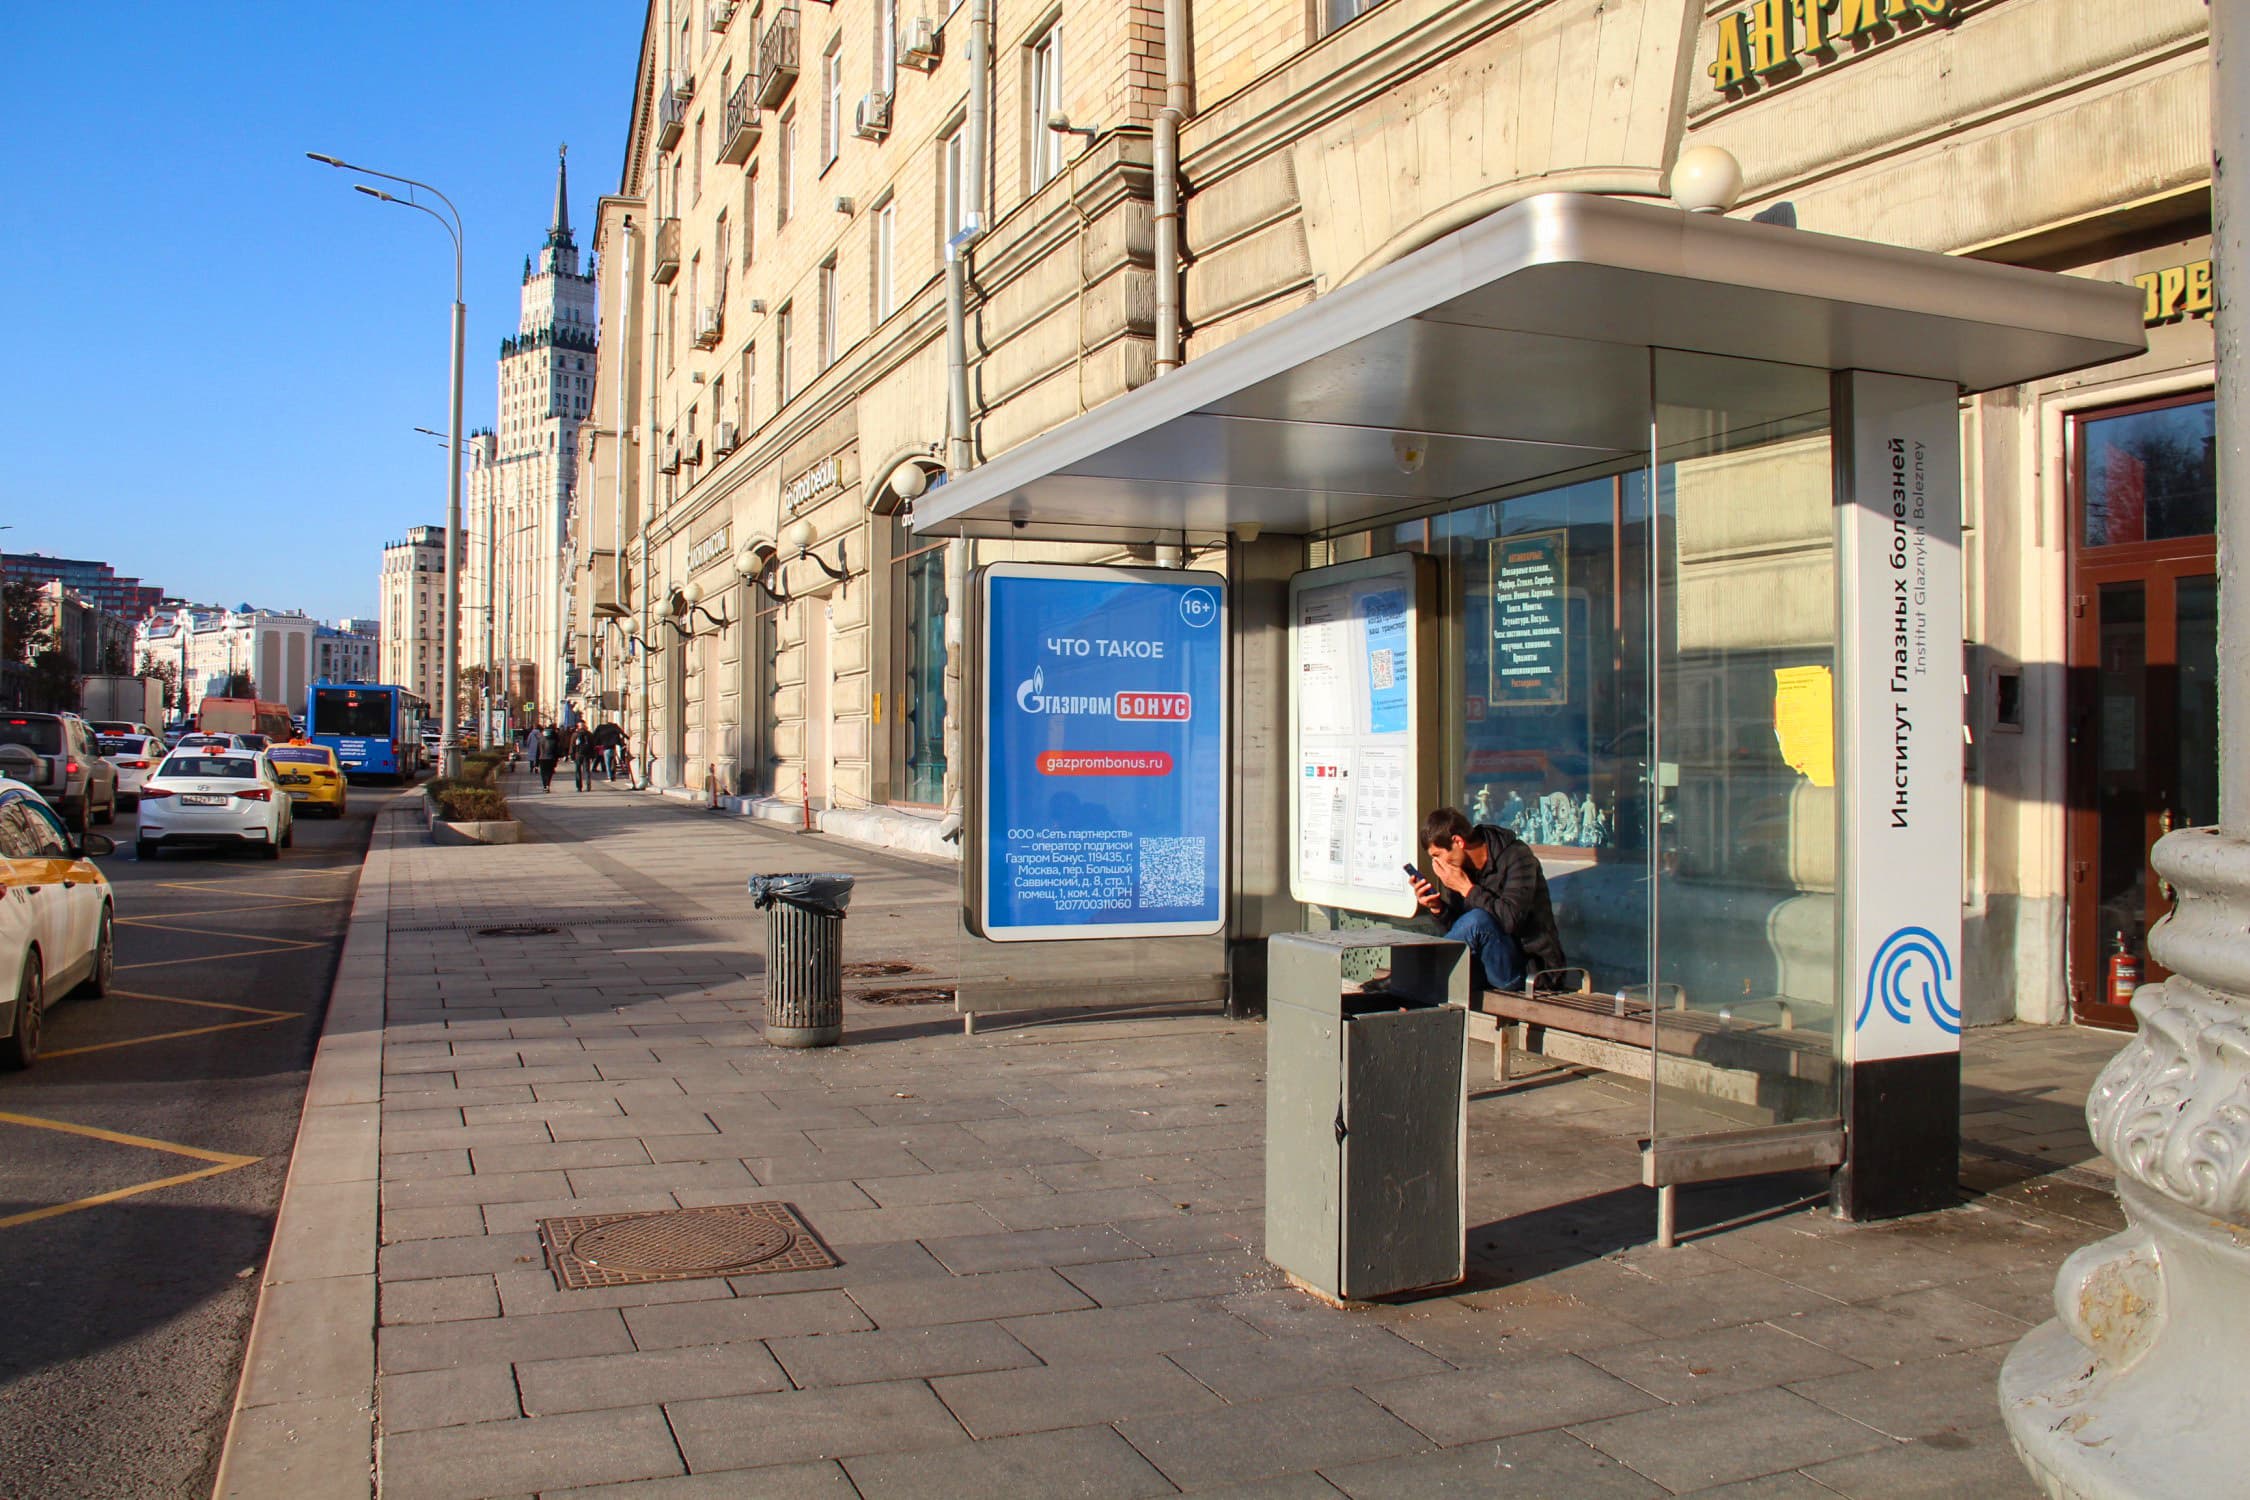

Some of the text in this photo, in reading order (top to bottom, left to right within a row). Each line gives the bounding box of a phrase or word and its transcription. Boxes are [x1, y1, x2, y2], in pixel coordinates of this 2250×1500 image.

[1708, 0, 1946, 91] АНТ
[1914, 441, 1929, 675] Institut Glaznykh Bolezney
[1184, 600, 1210, 614] 16+
[1888, 438, 1912, 828] Институт Глазных болезней
[1047, 638, 1165, 659] ЧТО ТАКОЕ
[1045, 696, 1187, 716] ГАЗПРОМ БОНУС
[1046, 757, 1163, 772] gazprombonus.ru
[1008, 829, 1133, 842] ООО «Сеть партнерств»
[1032, 843, 1081, 853] оператор
[1083, 842, 1133, 852] подписки
[1005, 853, 1050, 865] Газпром
[1052, 852, 1086, 865] Бонус.
[1088, 852, 1125, 863] 119435,
[1018, 864, 1133, 878] Москва, пер. Большой
[1014, 877, 1081, 889] Саввинский,
[1103, 888, 1133, 897] ОГРН
